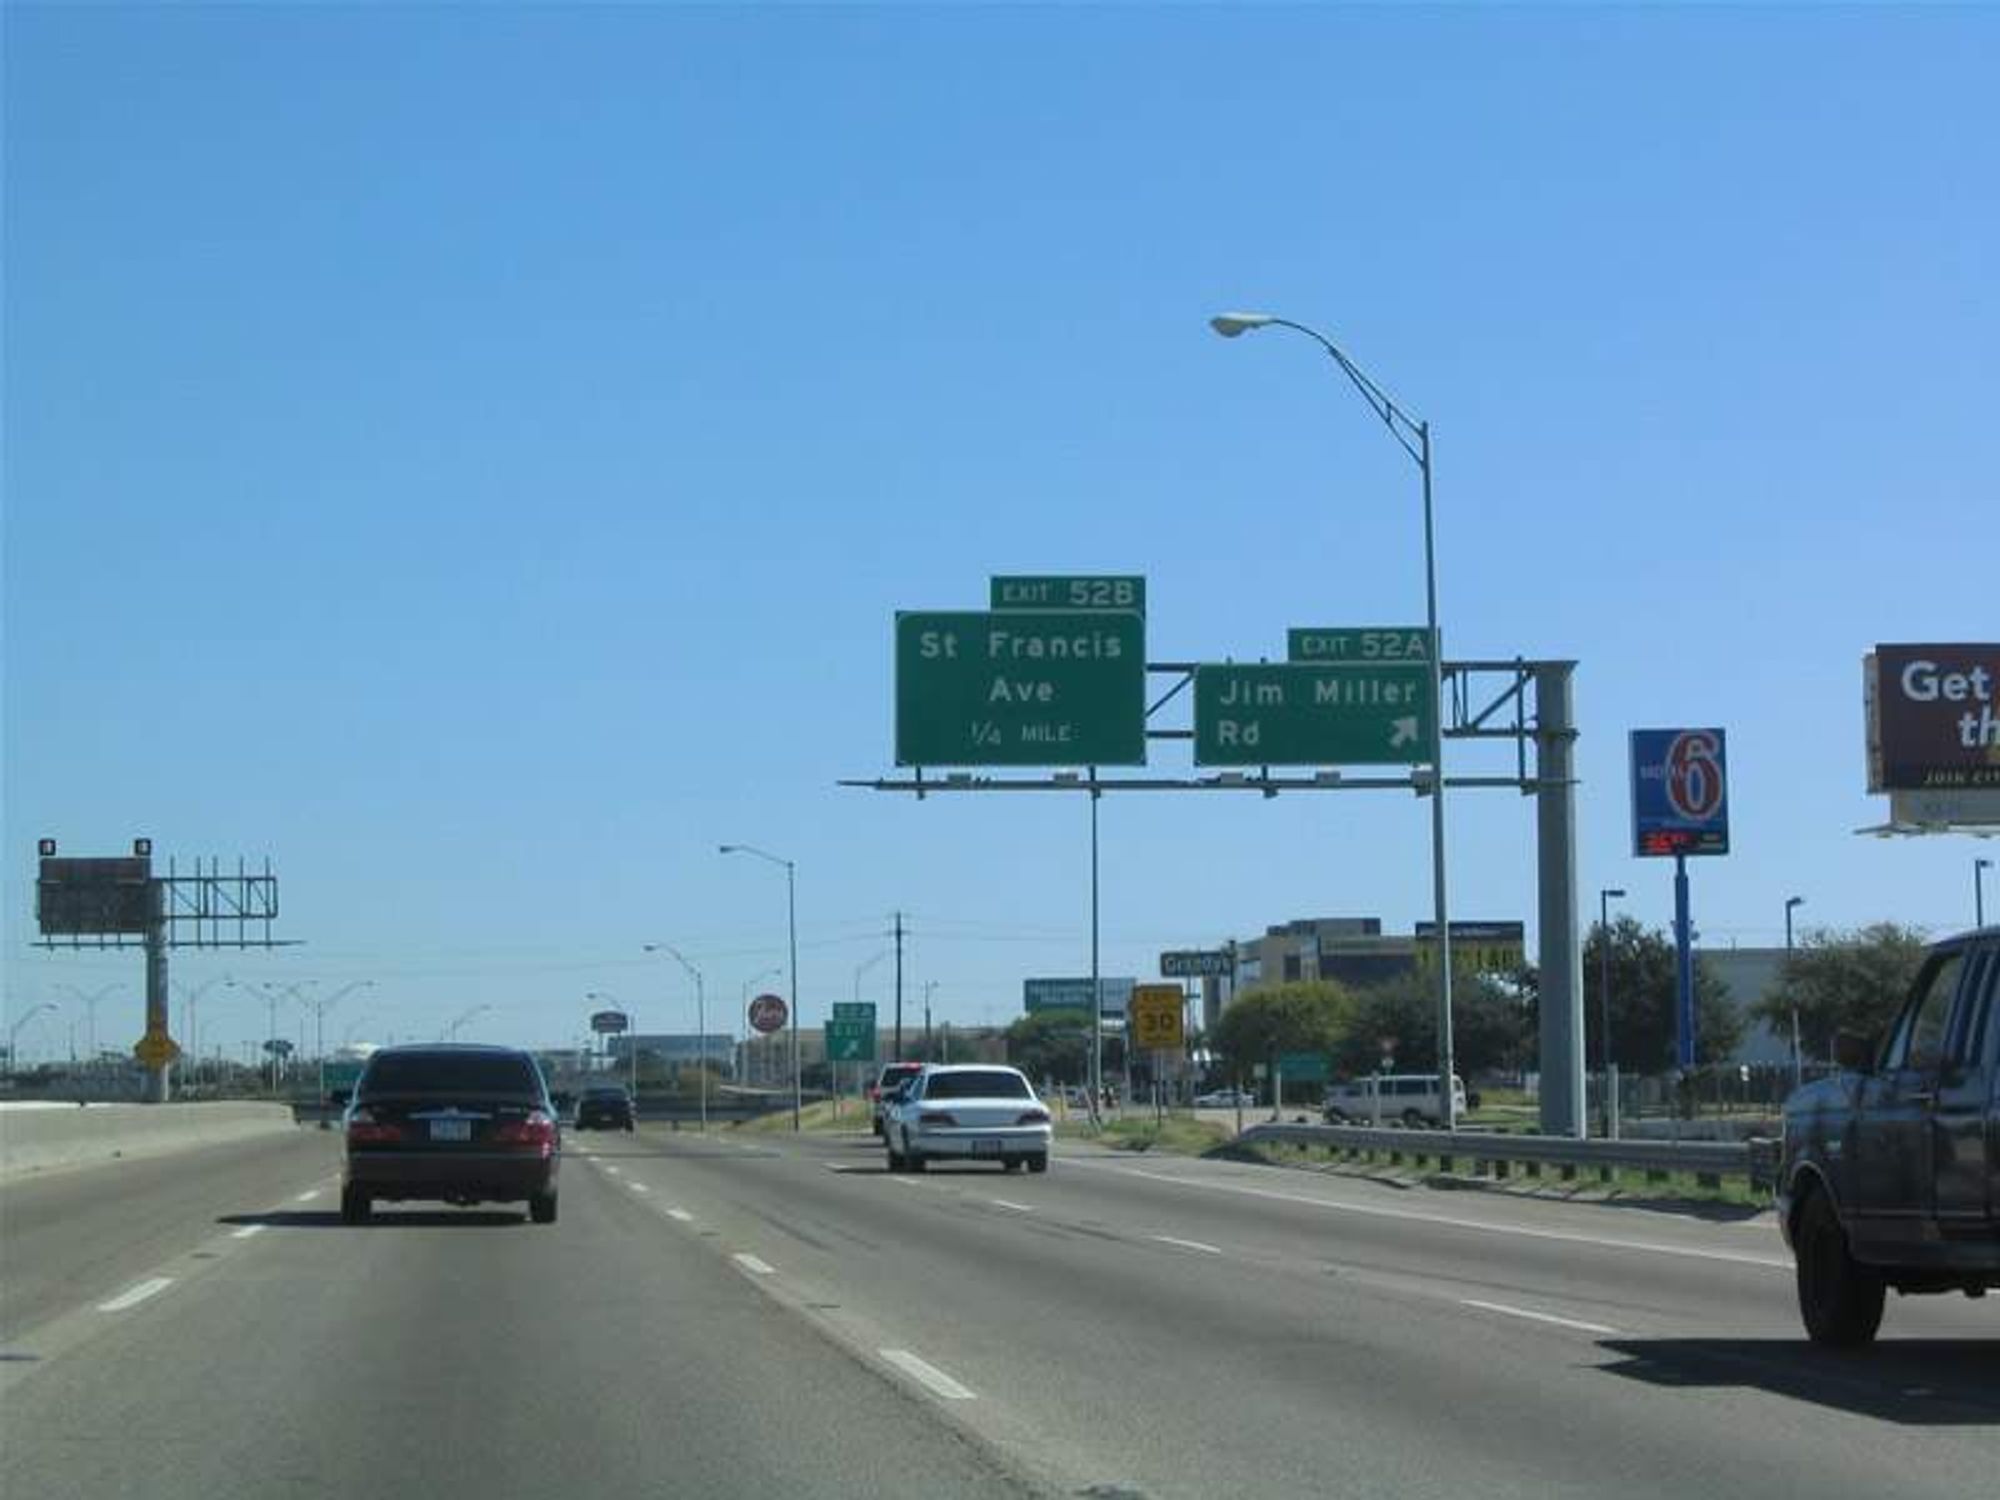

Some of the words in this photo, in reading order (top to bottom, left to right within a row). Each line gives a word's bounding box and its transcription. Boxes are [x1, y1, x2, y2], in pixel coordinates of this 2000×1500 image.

[1002, 583, 1050, 601] EXIT
[1069, 580, 1134, 604] 52B
[919, 631, 958, 657] St
[988, 631, 1122, 658] Francis
[1301, 635, 1349, 655] EXIT
[1361, 633, 1425, 656] 52A
[989, 677, 1054, 702] Ave
[1219, 679, 1283, 705] Jim
[1315, 679, 1417, 703] Miller
[1901, 660, 1990, 701] Get
[1021, 723, 1072, 742] MILE
[1218, 719, 1260, 746] Rd
[1666, 730, 1723, 818] 6
[1142, 1013, 1176, 1032] 30
